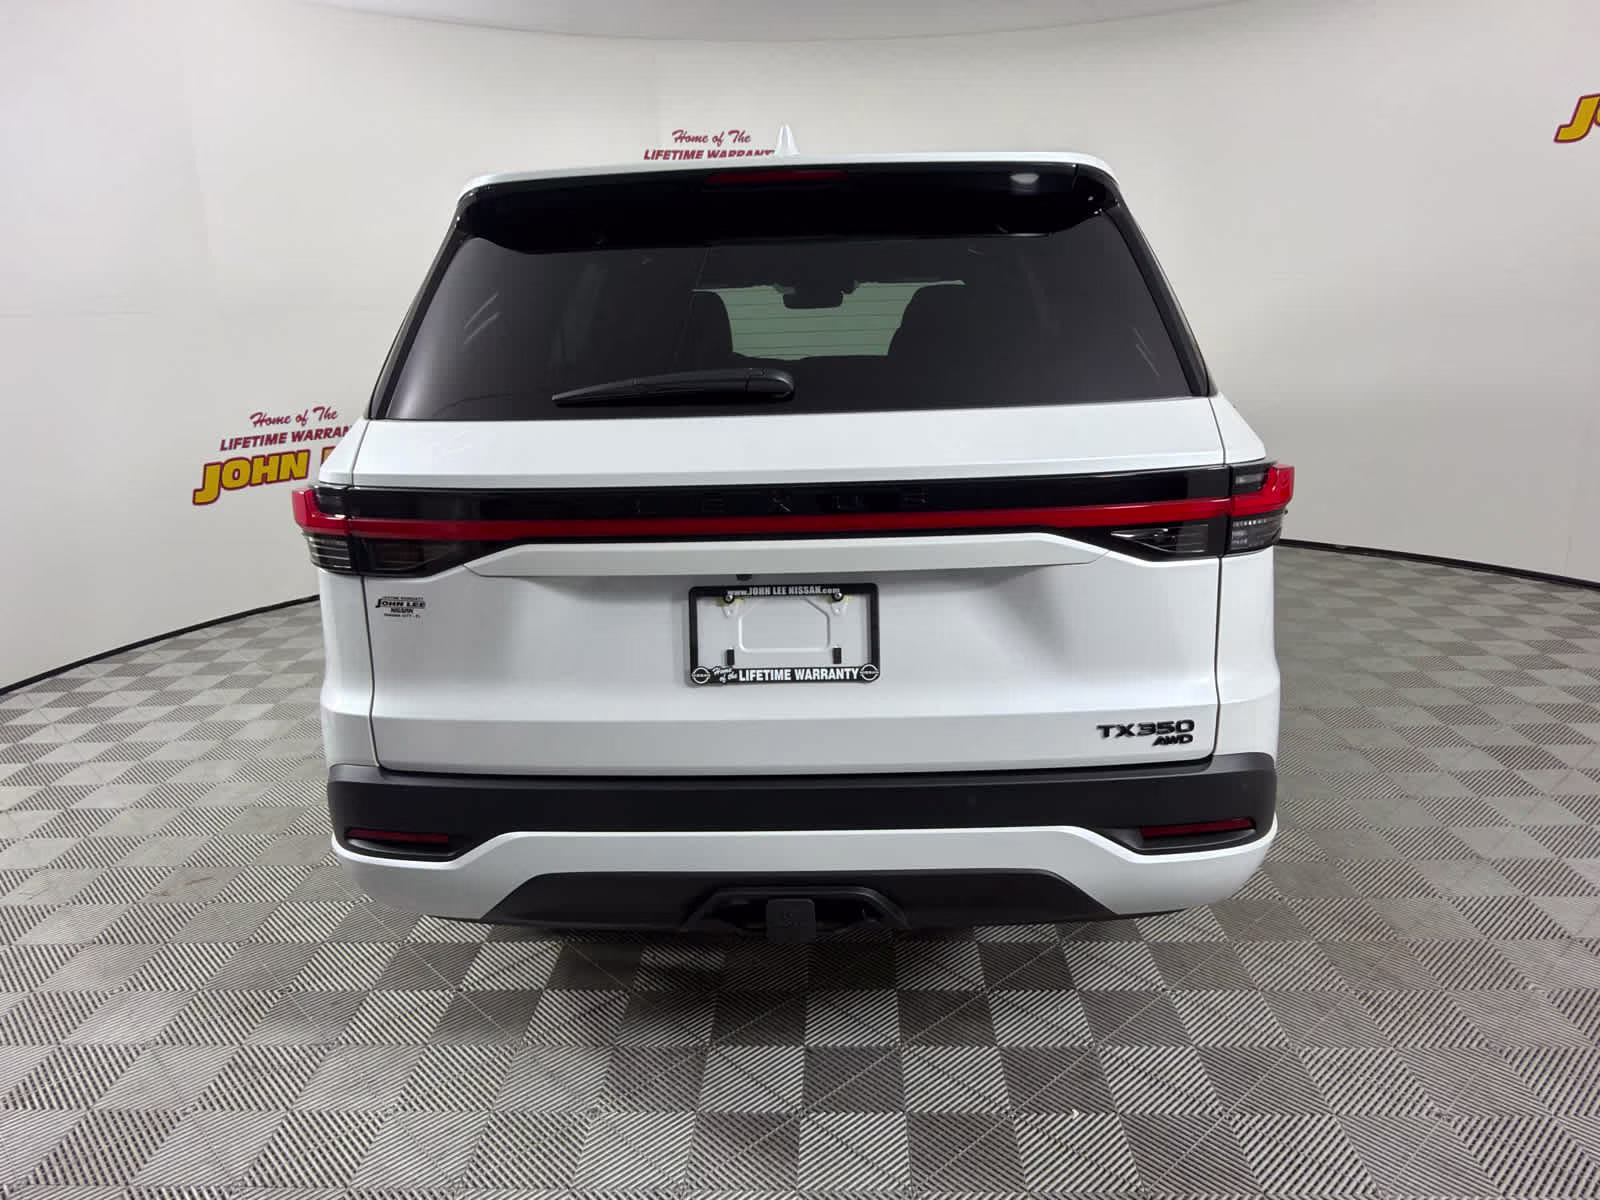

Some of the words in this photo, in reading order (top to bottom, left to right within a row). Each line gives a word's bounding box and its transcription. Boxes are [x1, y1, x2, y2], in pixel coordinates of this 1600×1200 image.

[672, 129, 709, 143] Home
[712, 131, 725, 147] of
[728, 129, 752, 143] The
[643, 149, 705, 160] LIFETIME
[250, 412, 291, 428] Home
[296, 409, 309, 427] of
[312, 406, 338, 421] The
[220, 432, 288, 451] LIFETIME
[192, 449, 311, 506] JOHN
[772, 585, 787, 596] LEE
[738, 668, 792, 682] LIFETIME
[793, 666, 860, 681] WARRANTY
[1096, 719, 1195, 739] TX350
[1151, 733, 1194, 747] AWD
